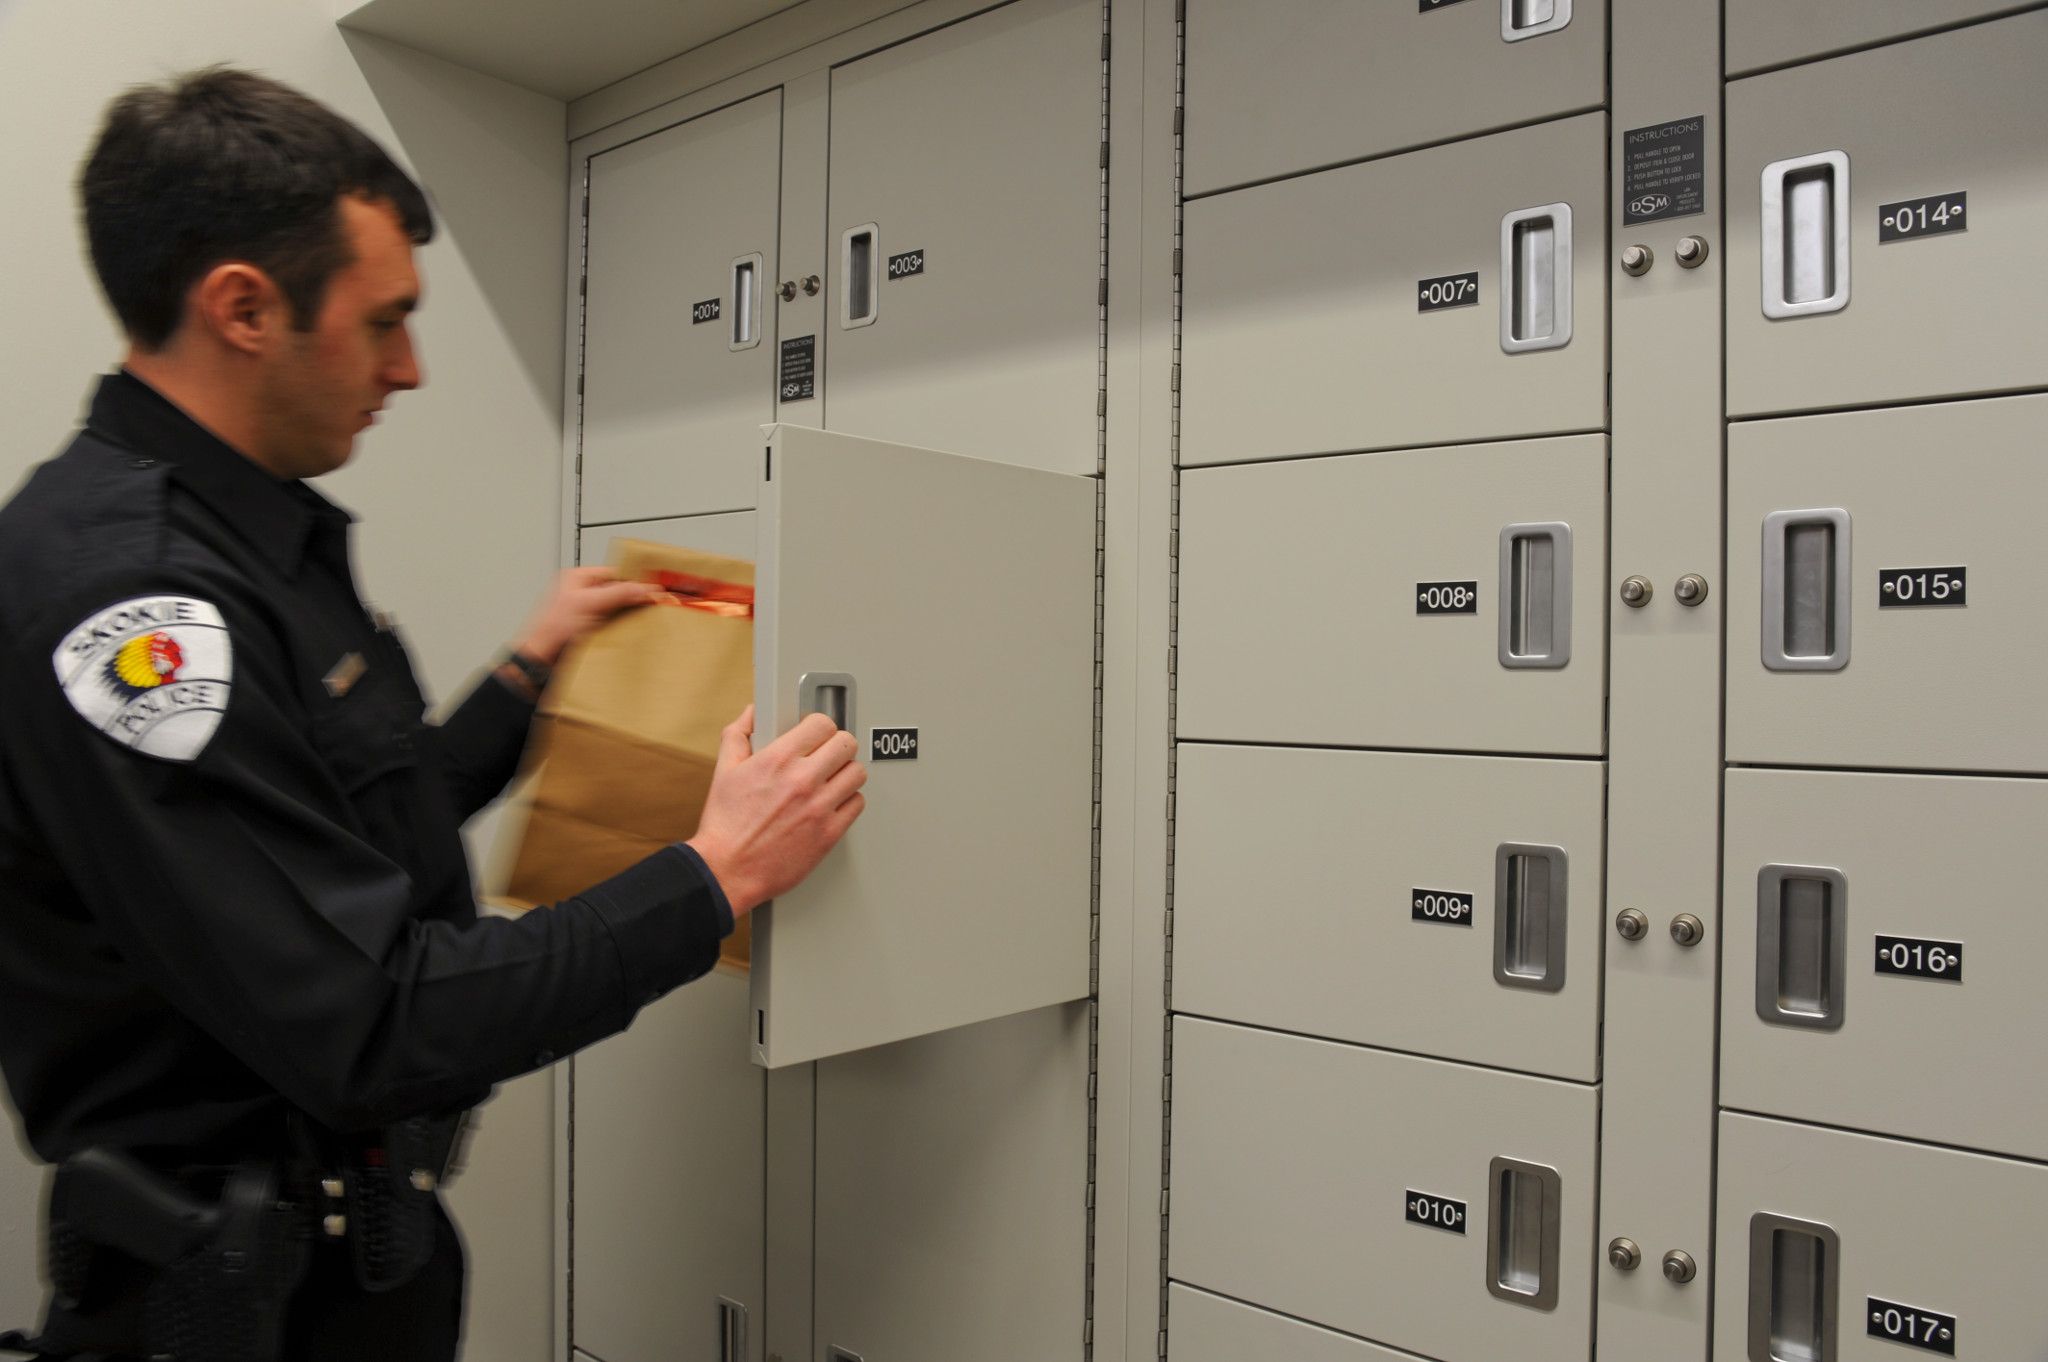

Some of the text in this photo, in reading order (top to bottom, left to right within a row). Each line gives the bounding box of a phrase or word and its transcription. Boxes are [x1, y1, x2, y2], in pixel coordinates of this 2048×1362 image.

[1629, 121, 1699, 144] INSTRUCTIONS
[1631, 196, 1668, 214] DSM
[1895, 201, 1951, 232] 014
[895, 255, 917, 274] 003
[1428, 279, 1468, 305] 007
[698, 304, 716, 320] 001
[1427, 586, 1467, 609] 008
[1896, 573, 1951, 600] 015
[880, 733, 910, 755] 004
[1423, 894, 1462, 919] 009
[1890, 943, 1948, 973] 016
[1416, 1198, 1456, 1226] 010
[1883, 1308, 1940, 1343] 017
